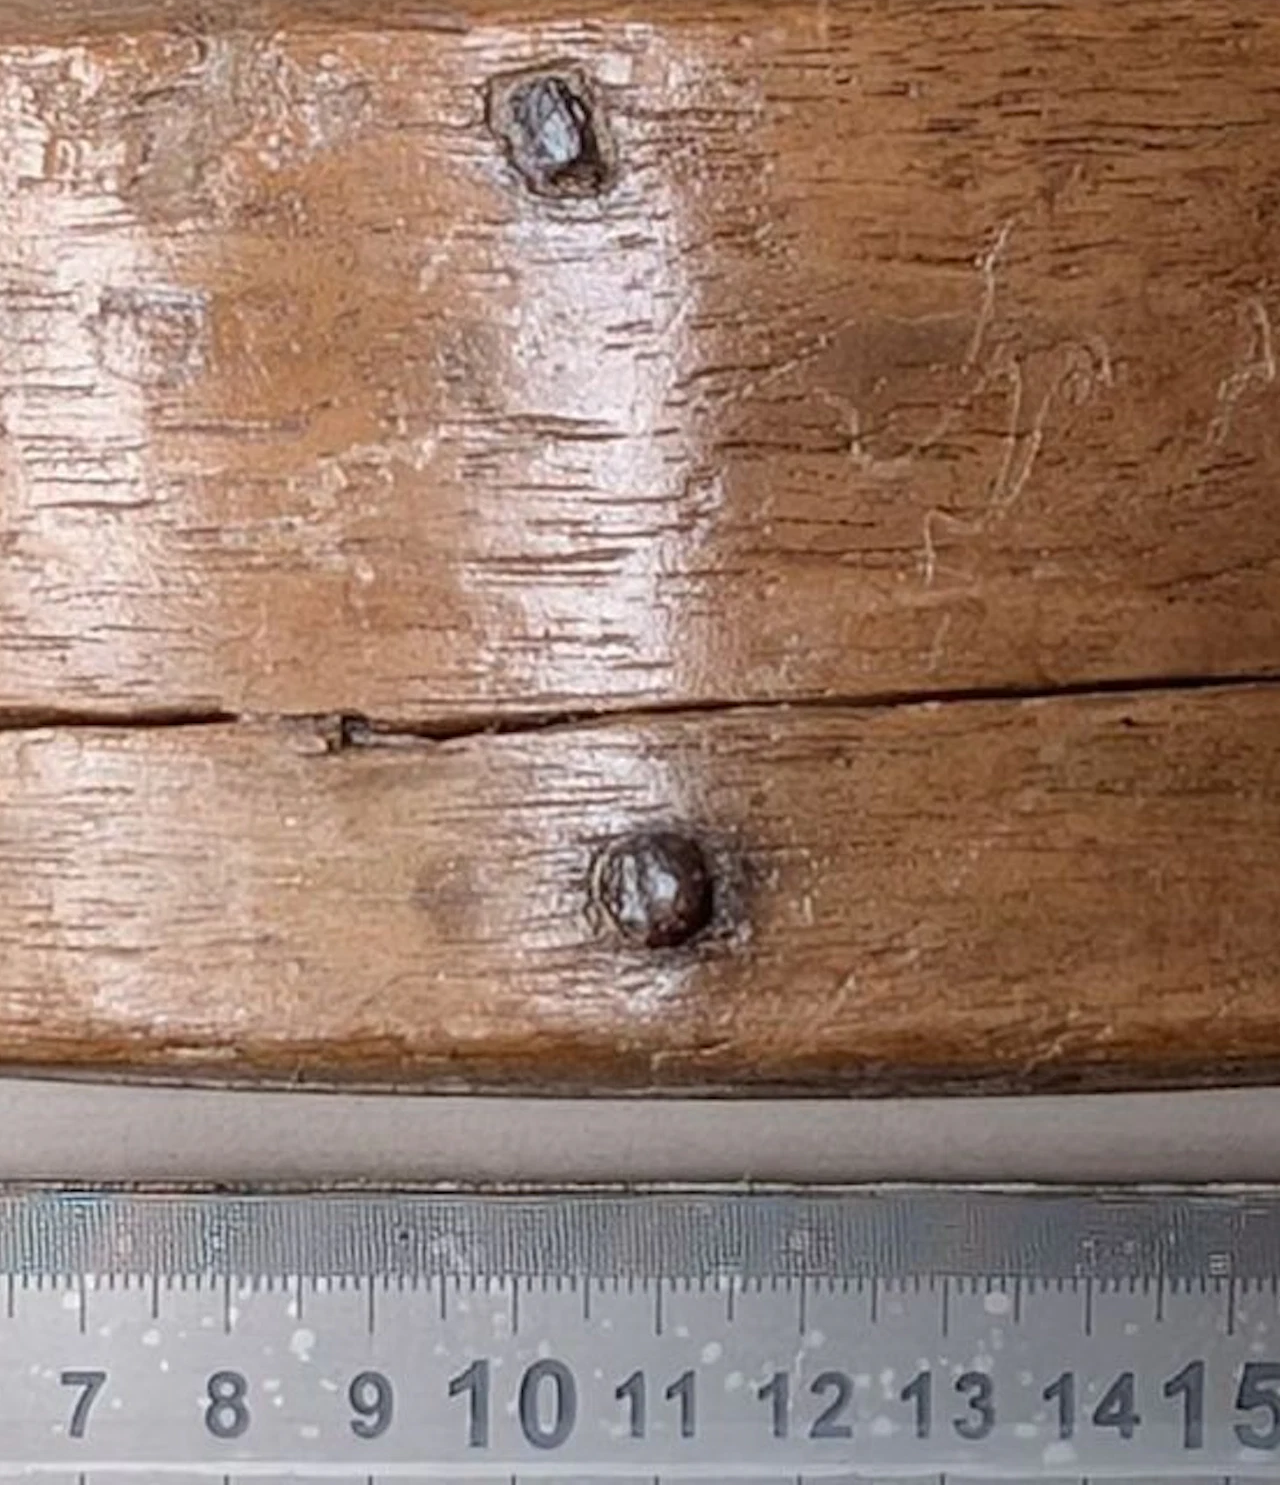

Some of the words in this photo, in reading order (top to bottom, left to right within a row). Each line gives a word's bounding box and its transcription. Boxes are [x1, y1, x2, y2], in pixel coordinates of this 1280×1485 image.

[59, 1370, 107, 1439] 7
[204, 1370, 251, 1440] 8
[347, 1370, 394, 1441] 9
[447, 1358, 577, 1451] 10
[614, 1369, 699, 1439] 11
[756, 1371, 853, 1440] 12
[900, 1370, 996, 1440] 13
[1042, 1371, 1142, 1440] 14
